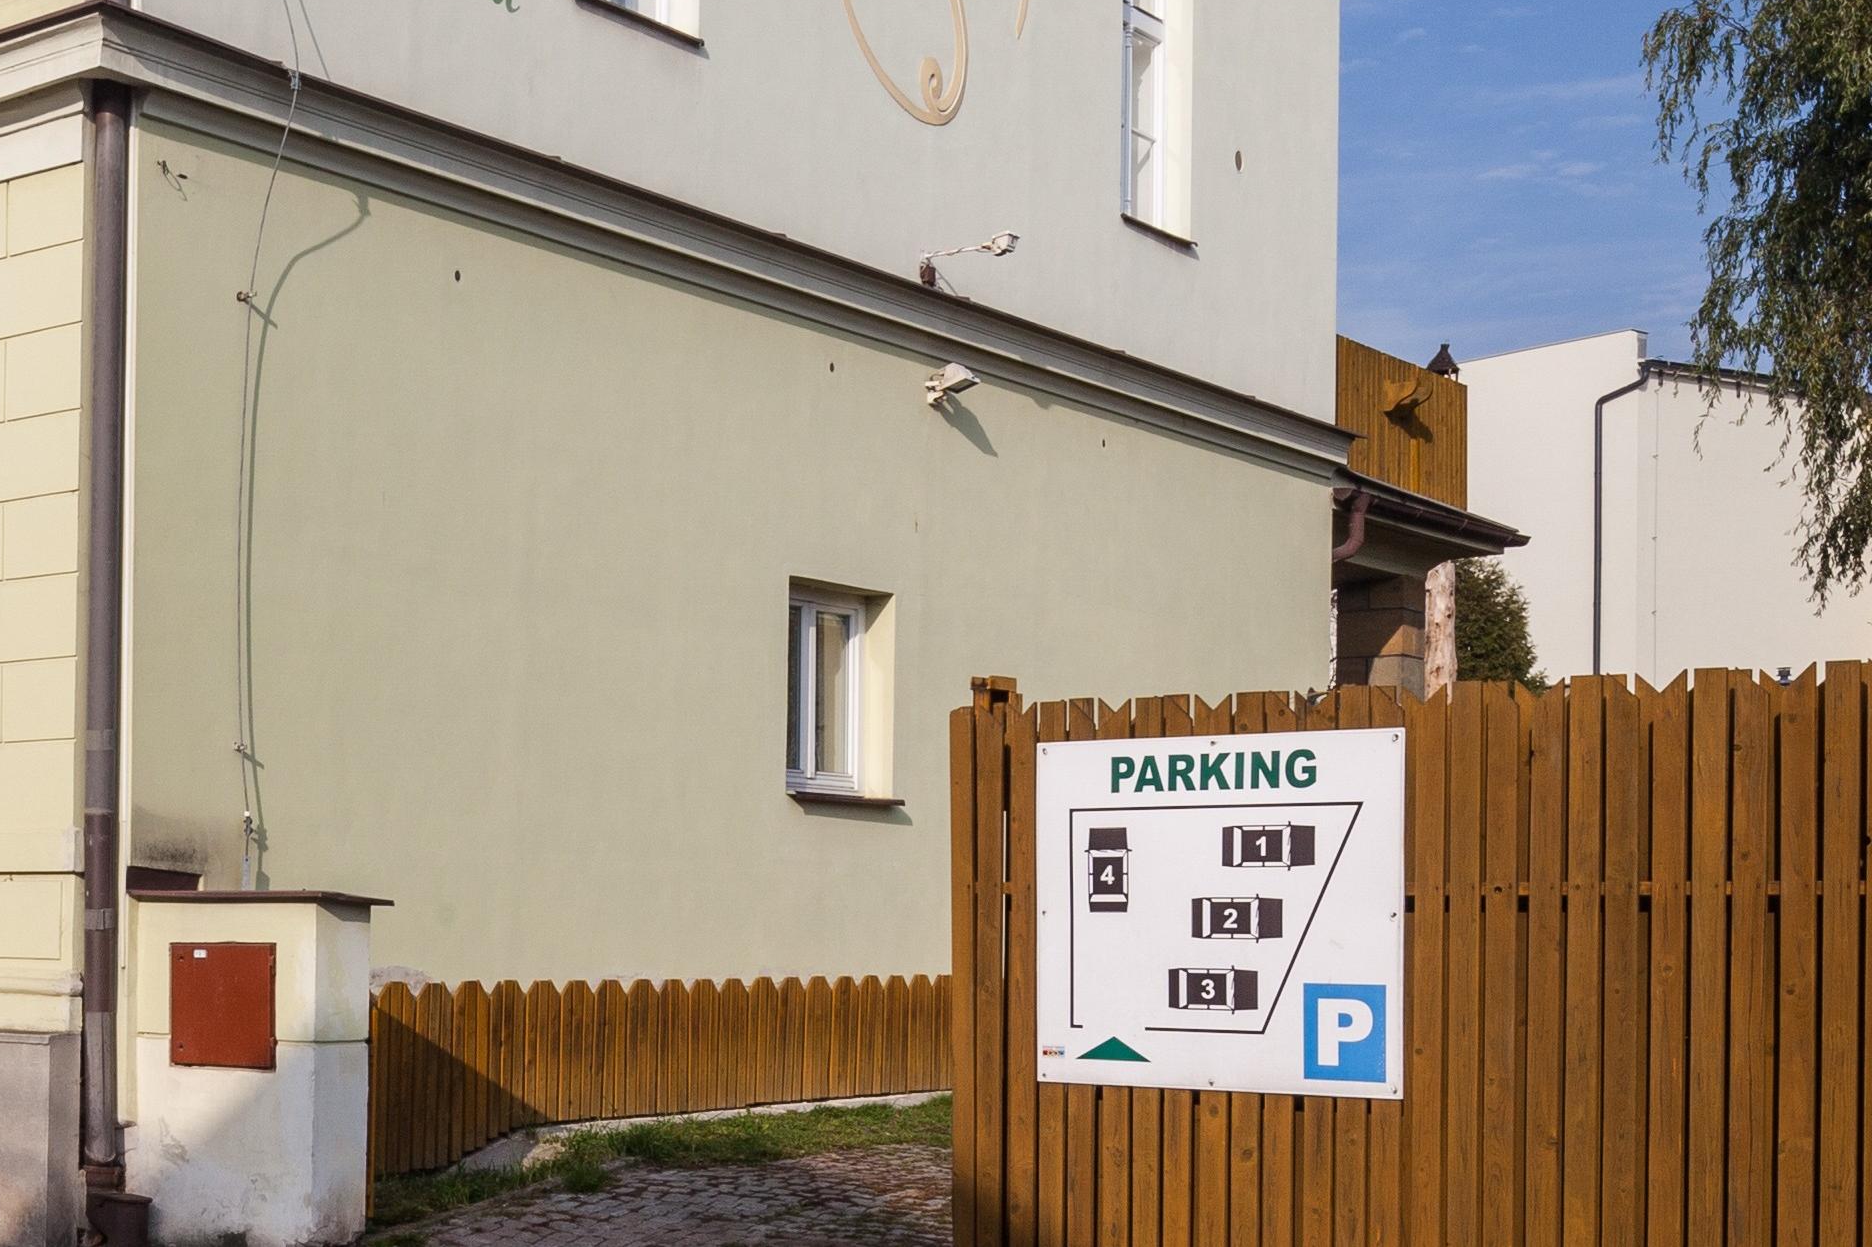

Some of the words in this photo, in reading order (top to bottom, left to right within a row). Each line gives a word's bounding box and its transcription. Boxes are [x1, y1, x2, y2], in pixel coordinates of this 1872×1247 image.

[1110, 748, 1318, 794] PARKING
[1255, 836, 1267, 857] 1
[1100, 865, 1115, 885] 4
[1223, 908, 1239, 929] 2
[1200, 979, 1217, 1000] 3
[1316, 997, 1374, 1067] P
